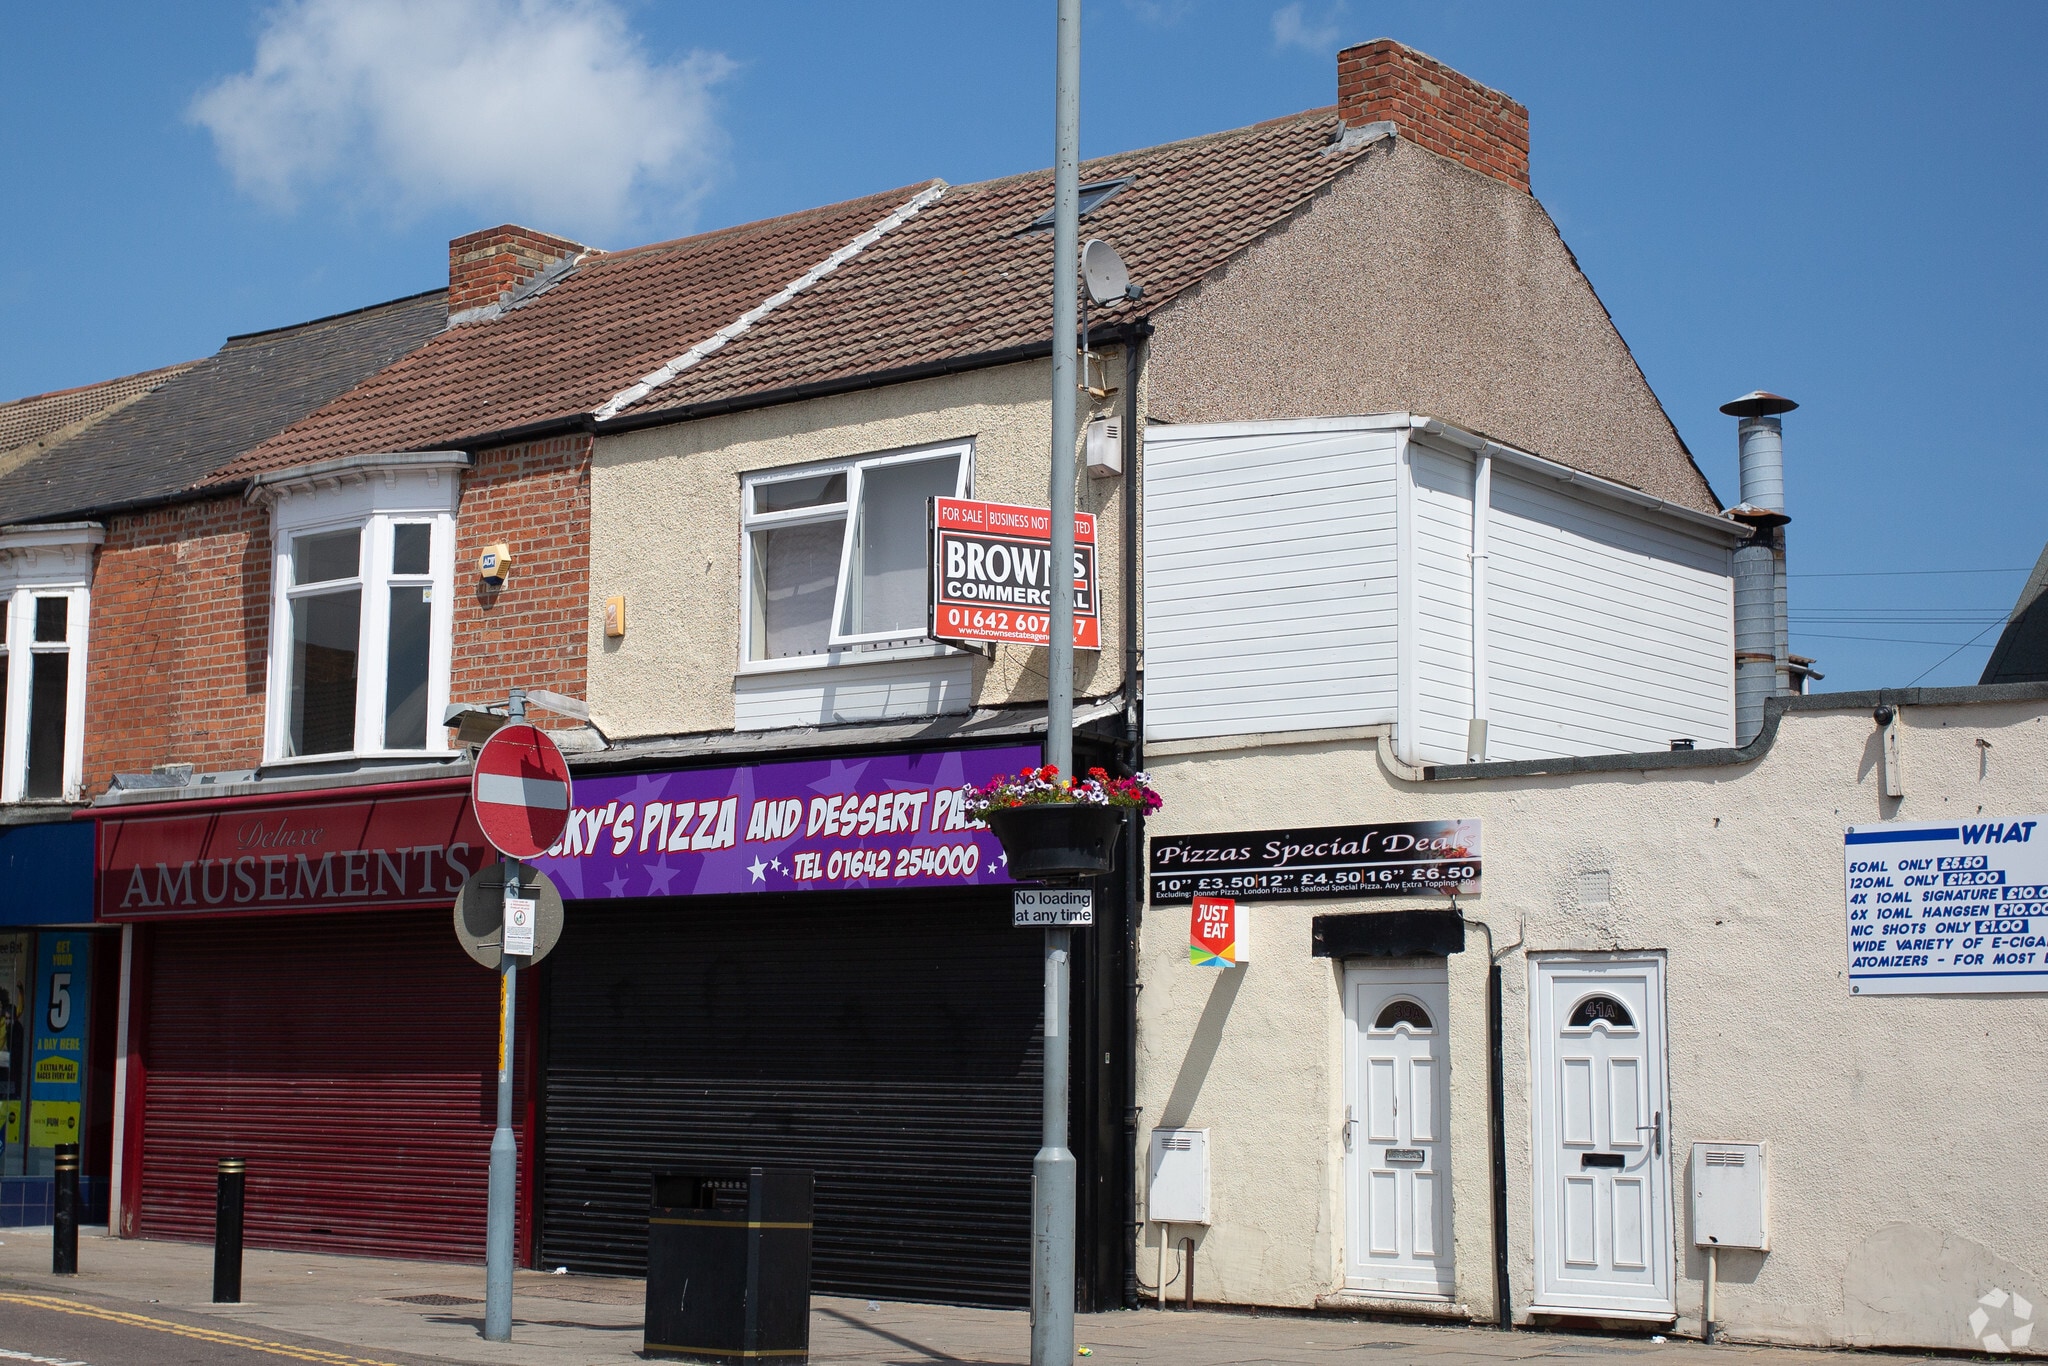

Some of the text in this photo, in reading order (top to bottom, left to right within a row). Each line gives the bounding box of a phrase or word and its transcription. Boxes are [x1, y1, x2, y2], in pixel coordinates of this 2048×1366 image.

[942, 507, 983, 523] FOR SALE
[990, 512, 1049, 530] BUSINESS NOT
[946, 540, 1086, 587] BROWS
[947, 581, 1089, 609] COMMERCL
[949, 609, 1087, 636] 01642 6077
[639, 796, 739, 853] PIZZA
[745, 798, 803, 842] AND
[806, 791, 928, 838] DESSERT
[237, 818, 326, 851] Deluxe
[1962, 821, 2037, 845] WHAT
[1156, 824, 1476, 868] Pizzas Special Deals
[794, 844, 980, 881] TEL 01642 254000
[1849, 856, 1984, 873] 50ML ONLY £5.50
[120, 842, 471, 908] AMUSEMENTS
[1300, 871, 1361, 885] £4.50
[1411, 866, 1476, 881] £6.50
[1850, 871, 1999, 889] 120ML ONLY £12.00
[1156, 891, 1192, 899] Excluding:
[1243, 887, 1271, 895] London
[1272, 886, 1292, 894] Pizza
[1300, 884, 1330, 893] Seafood
[1331, 883, 1358, 892] Special
[1385, 881, 1400, 890] Any
[1401, 880, 1423, 888] Extra
[1424, 879, 1459, 888] Toppings
[1198, 876, 1256, 890] £3.50
[1015, 892, 1091, 907] No loading
[1850, 892, 1867, 905] 4X
[1876, 891, 1912, 904] 10ML
[1922, 888, 1999, 902] SIGNATURE
[1015, 909, 1092, 923] at any time
[1197, 904, 1229, 923] JUST
[1850, 908, 1868, 920] 6X
[1876, 907, 1913, 920] 10ML
[1922, 905, 1990, 918] HANGSEN
[1203, 922, 1229, 939] EAT
[1851, 919, 2023, 936] NIC SHOTS ONLY £1.00
[1852, 936, 2048, 952] WIDE VARIETY OF E-CIGA
[1852, 955, 1929, 968] ATOMIZERS
[1953, 953, 1985, 966] FOR
[1992, 952, 2036, 965] MOST
[49, 972, 72, 1031] 5
[1585, 1001, 1615, 1018] 41A
[1394, 1004, 1421, 1019] 39A
[44, 1038, 58, 1050] DAY
[59, 1038, 80, 1051] HERE
